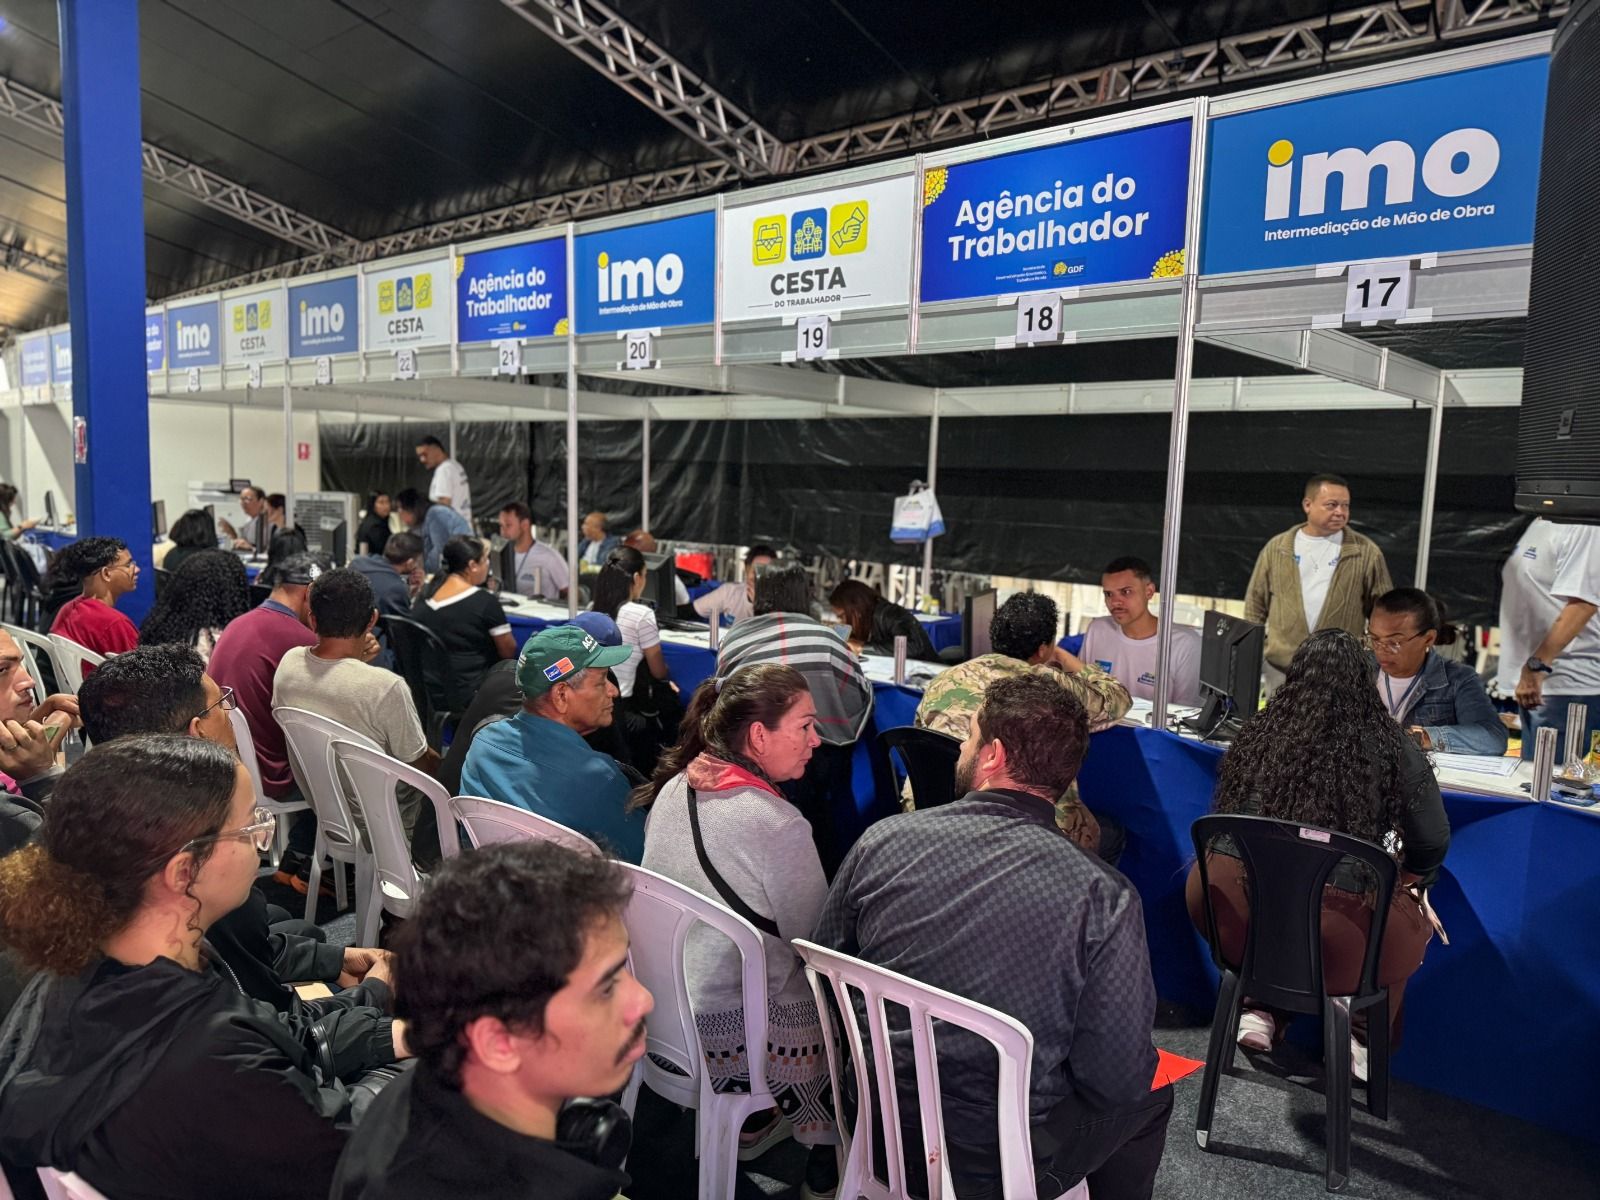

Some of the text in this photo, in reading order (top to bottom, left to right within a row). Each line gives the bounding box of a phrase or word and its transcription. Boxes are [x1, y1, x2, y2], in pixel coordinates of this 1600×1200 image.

[1264, 127, 1500, 222] imo
[955, 172, 1136, 232] Agência do
[948, 210, 1150, 262] Trabalhador
[1264, 203, 1496, 242] Intermediação de Mão de Obra
[468, 266, 546, 300] Agência do
[598, 251, 684, 303] imo
[770, 266, 847, 296] CESTA
[1067, 264, 1084, 275] GDF
[465, 290, 552, 318] Trabalhador
[774, 294, 841, 308] DO TRABALHADOR
[1356, 276, 1401, 308] 17
[300, 300, 344, 337] imo
[387, 316, 424, 336] CESTA
[1023, 306, 1053, 332] 18
[176, 320, 211, 351] imo
[240, 335, 266, 351] CESTA
[630, 341, 647, 360] 20
[802, 327, 824, 349] 19
[502, 350, 515, 366] 21
